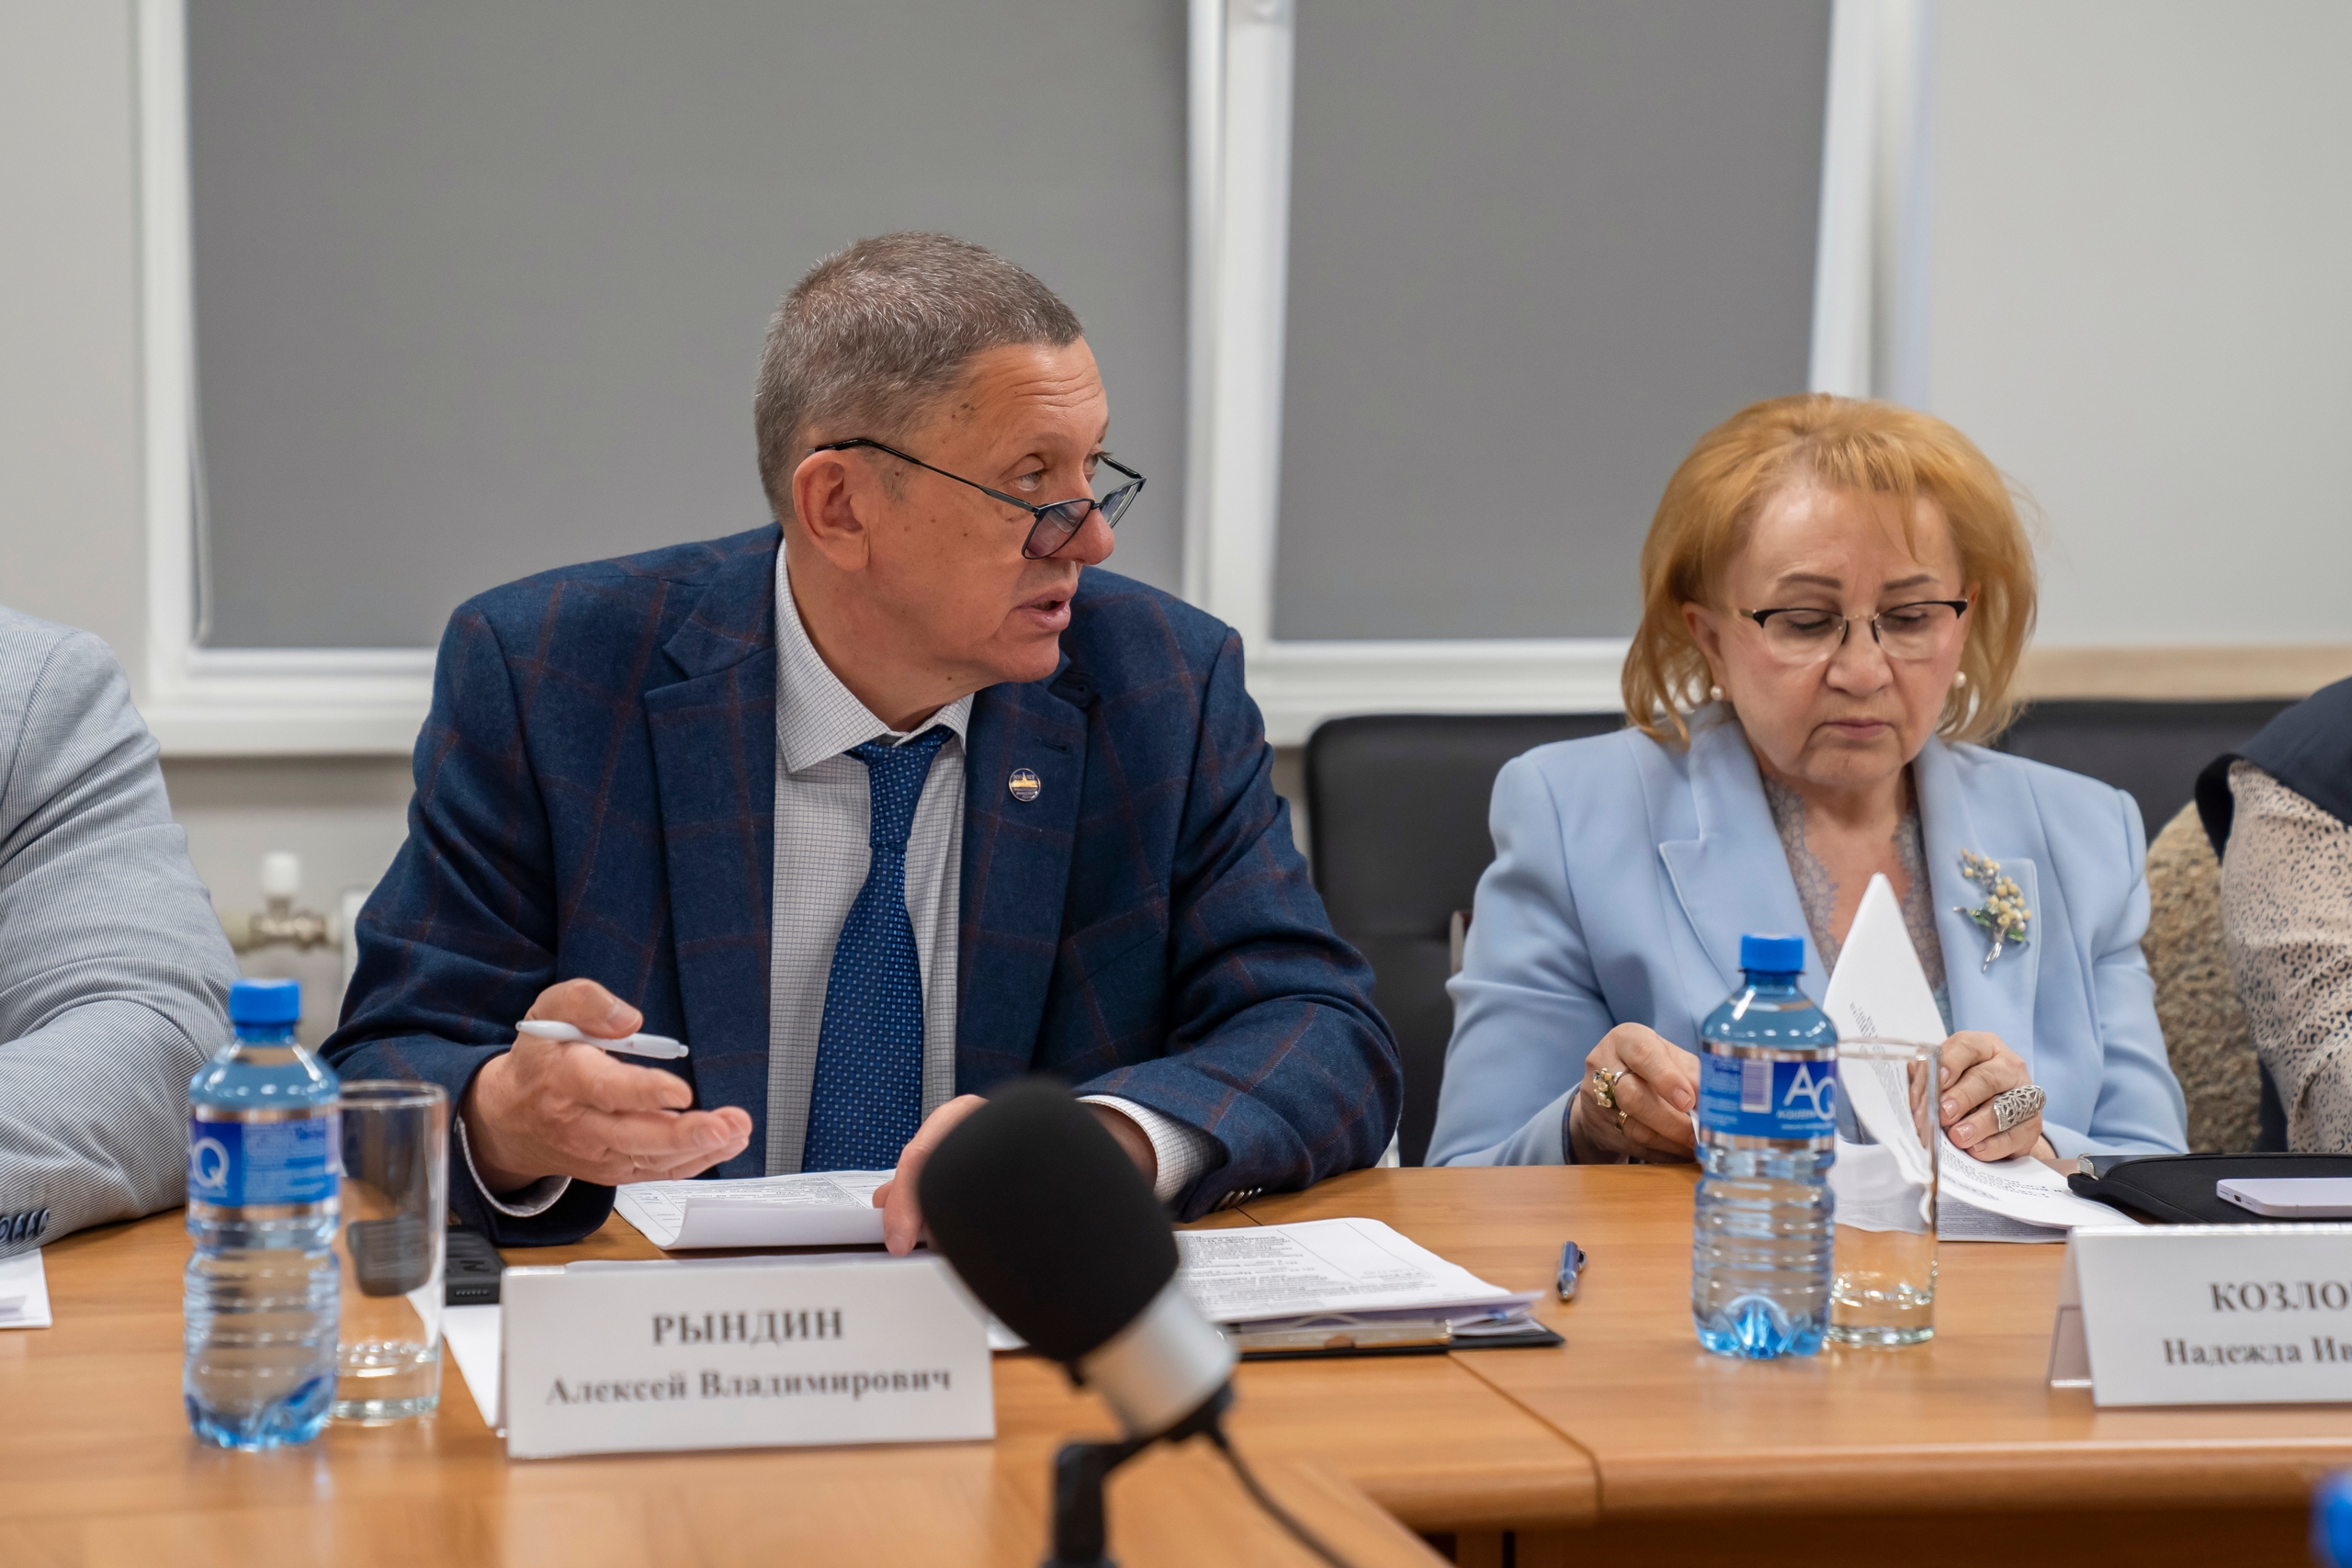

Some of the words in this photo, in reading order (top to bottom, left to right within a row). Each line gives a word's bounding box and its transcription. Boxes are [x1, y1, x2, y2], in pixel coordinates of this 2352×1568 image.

[2209, 1280, 2352, 1312] КОЗЛО
[651, 1309, 842, 1348] РЫНДИН
[2164, 1337, 2301, 1367] Надежда
[546, 1371, 686, 1405] Алексей
[700, 1368, 951, 1402] Владимирович
